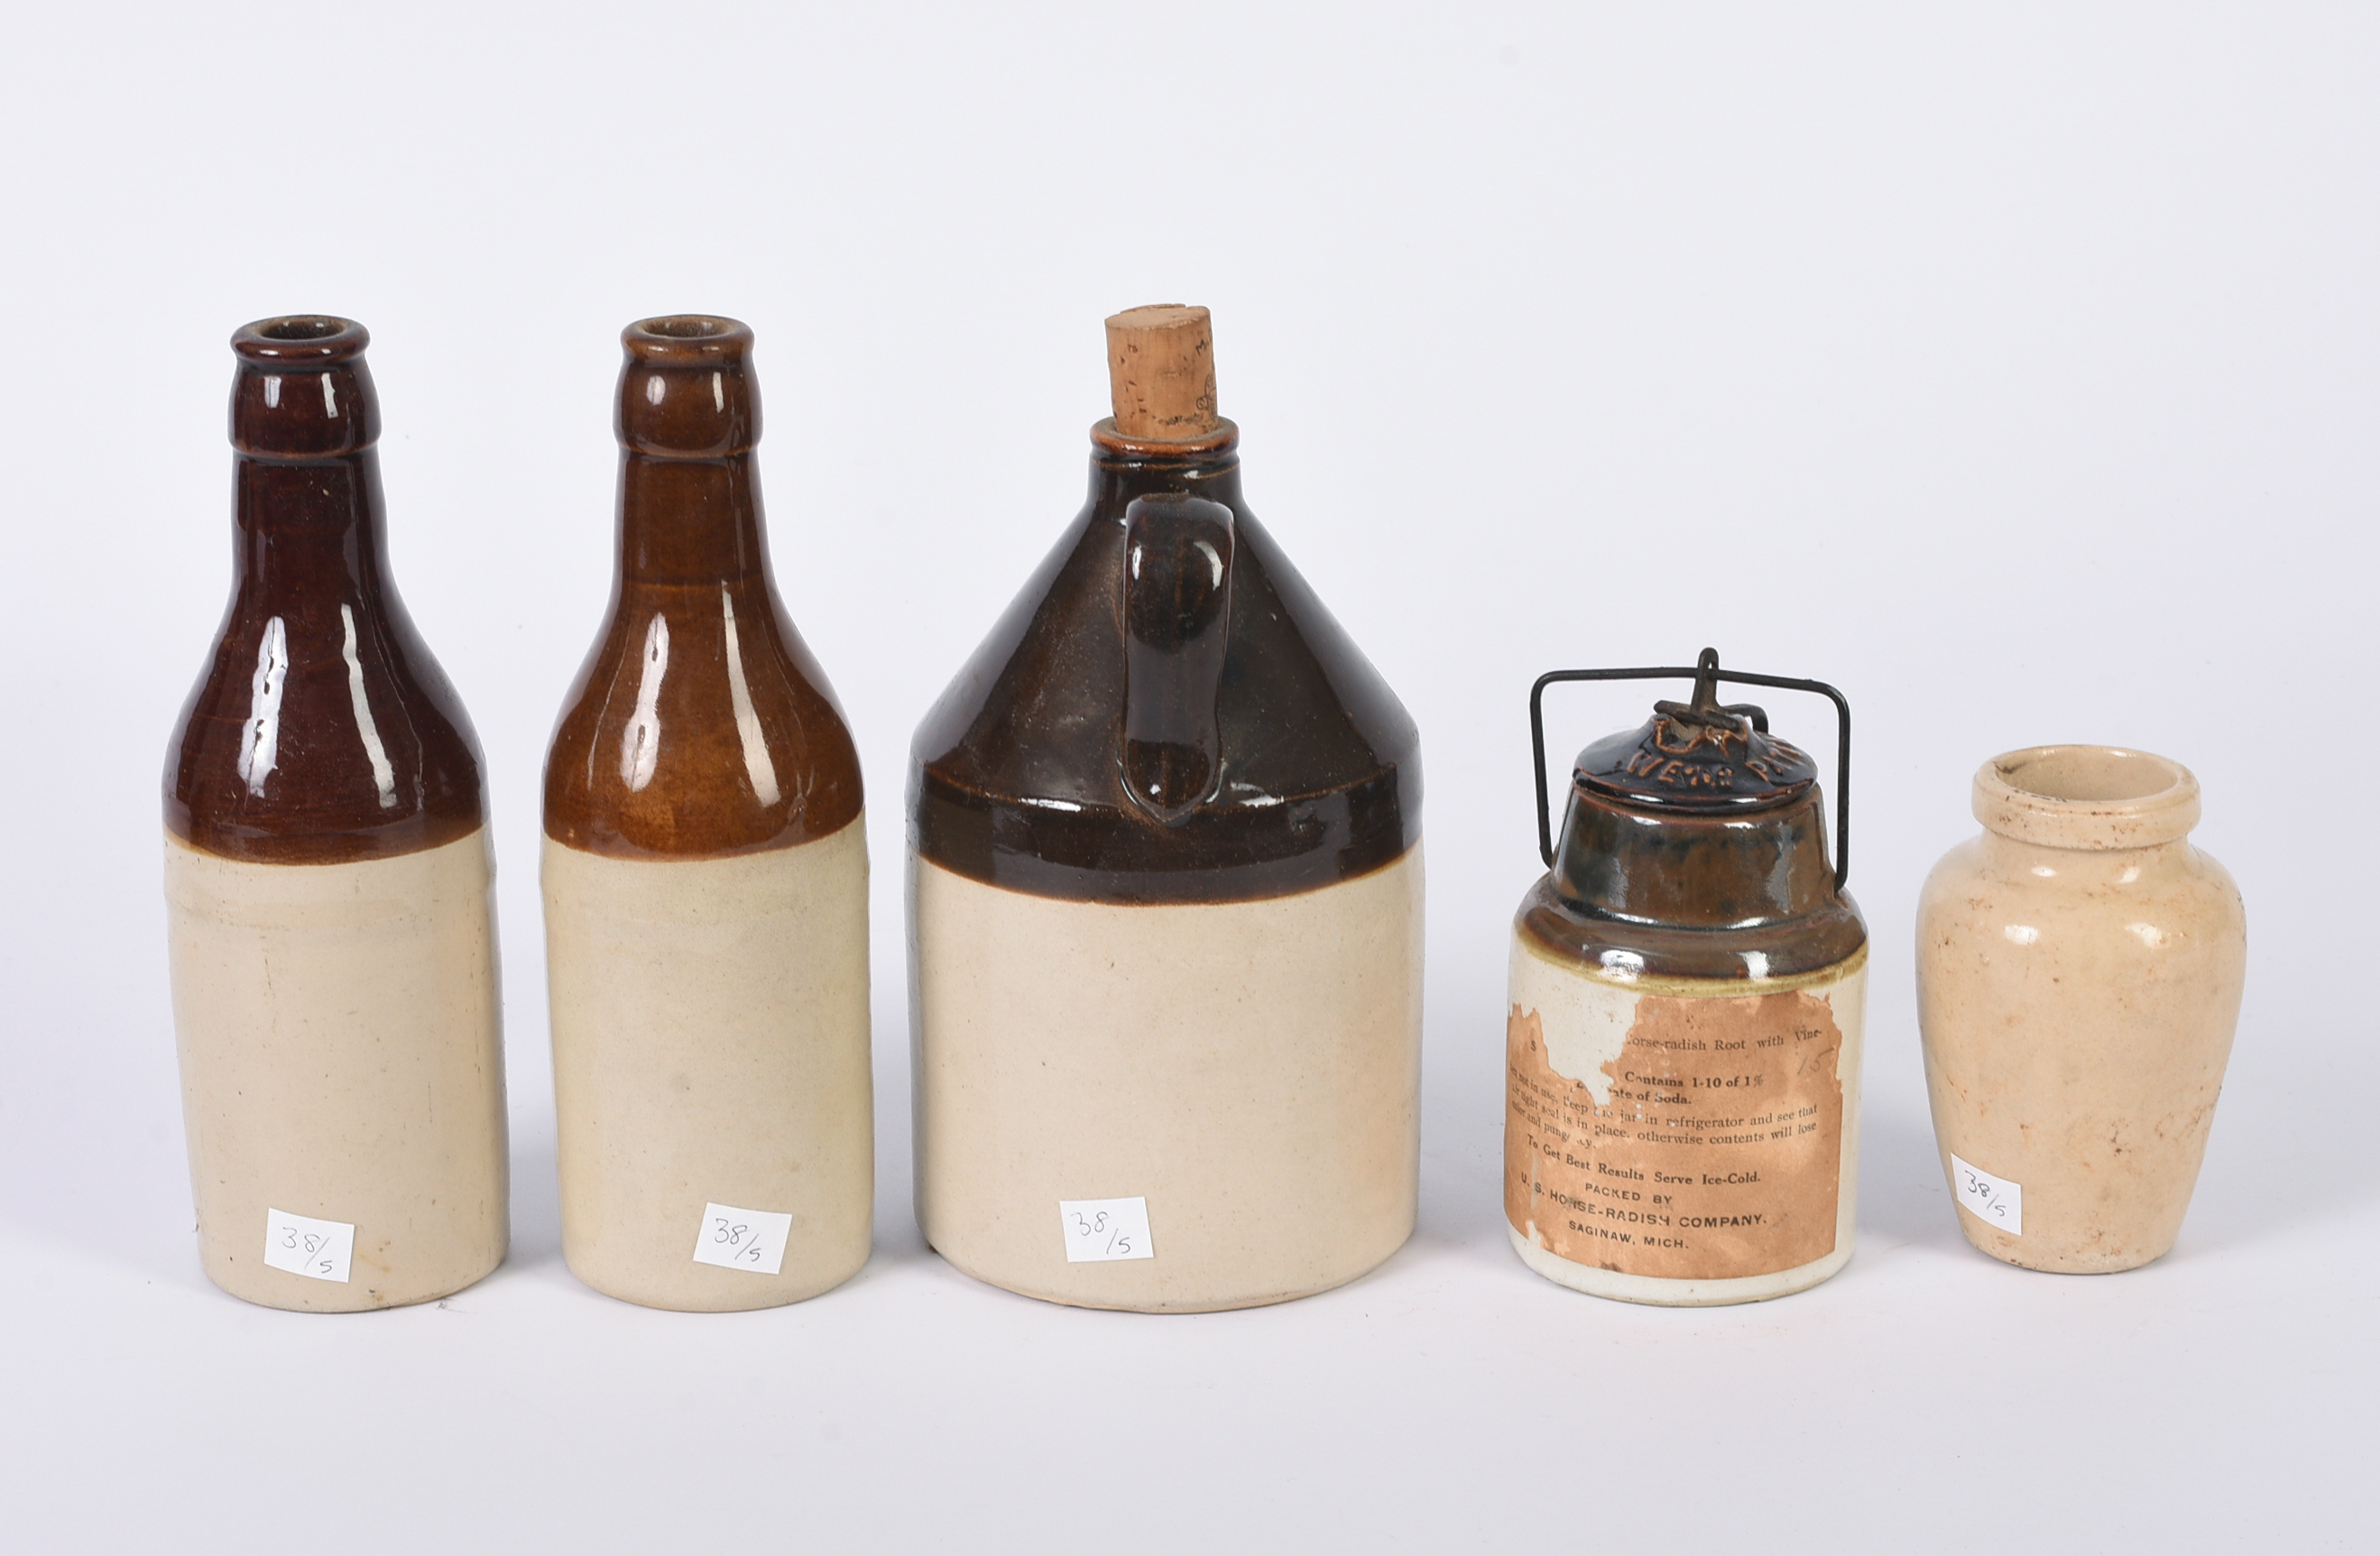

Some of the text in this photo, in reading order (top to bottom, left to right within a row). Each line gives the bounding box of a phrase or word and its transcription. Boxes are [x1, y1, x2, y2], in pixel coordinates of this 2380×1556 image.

[1627, 1036, 1707, 1051] orse-radish
[1714, 1039, 1747, 1051] Root
[1757, 1036, 1785, 1048] with
[1794, 1028, 1822, 1043] Vine-
[1625, 1072, 1684, 1088] Contains
[1692, 1078, 1722, 1089] 1-10
[1726, 1075, 1741, 1088] of
[1530, 1079, 1539, 1093] in
[1619, 1109, 1637, 1124] jar
[1646, 1112, 1658, 1126] in
[1666, 1116, 1745, 1131] refrigerator
[1750, 1113, 1773, 1127] and
[1776, 1110, 1795, 1123] see
[1798, 1103, 1818, 1118] that
[1637, 1091, 1651, 1102] of
[1654, 1091, 1693, 1105] Soda.
[1527, 1113, 1541, 1128] and
[1563, 1112, 1573, 1125] is
[1577, 1118, 1588, 1130] in
[1637, 1131, 1703, 1146] otherwise
[1710, 1132, 1765, 1145] contents
[1770, 1126, 1792, 1140] will
[1797, 1120, 1817, 1136] lose
[1527, 1133, 1761, 1185] To Get Best Results Serve Ice-Cold.
[1521, 1172, 1530, 1187] U.
[1535, 1182, 1545, 1196] S.
[1679, 1214, 1767, 1229] COMPANY.
[1585, 1183, 1673, 1205] PACKED BY
[1568, 1220, 1689, 1249] SAGINAW, MICH.
